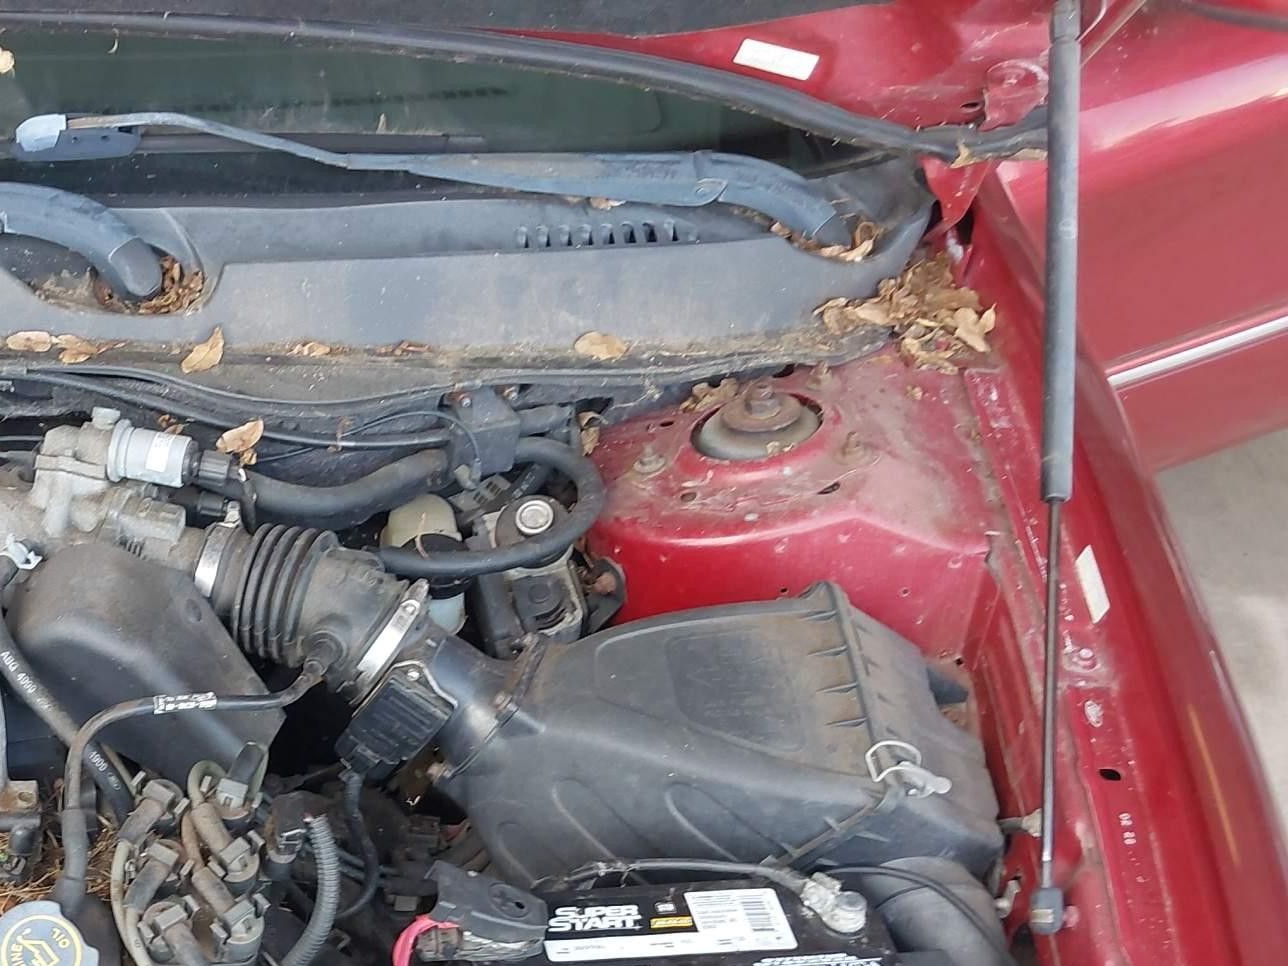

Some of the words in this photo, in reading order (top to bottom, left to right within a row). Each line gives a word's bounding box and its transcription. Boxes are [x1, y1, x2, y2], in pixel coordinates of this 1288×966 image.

[555, 905, 640, 918] SUPER
[548, 915, 642, 933] START
[52, 927, 71, 949] OIL
